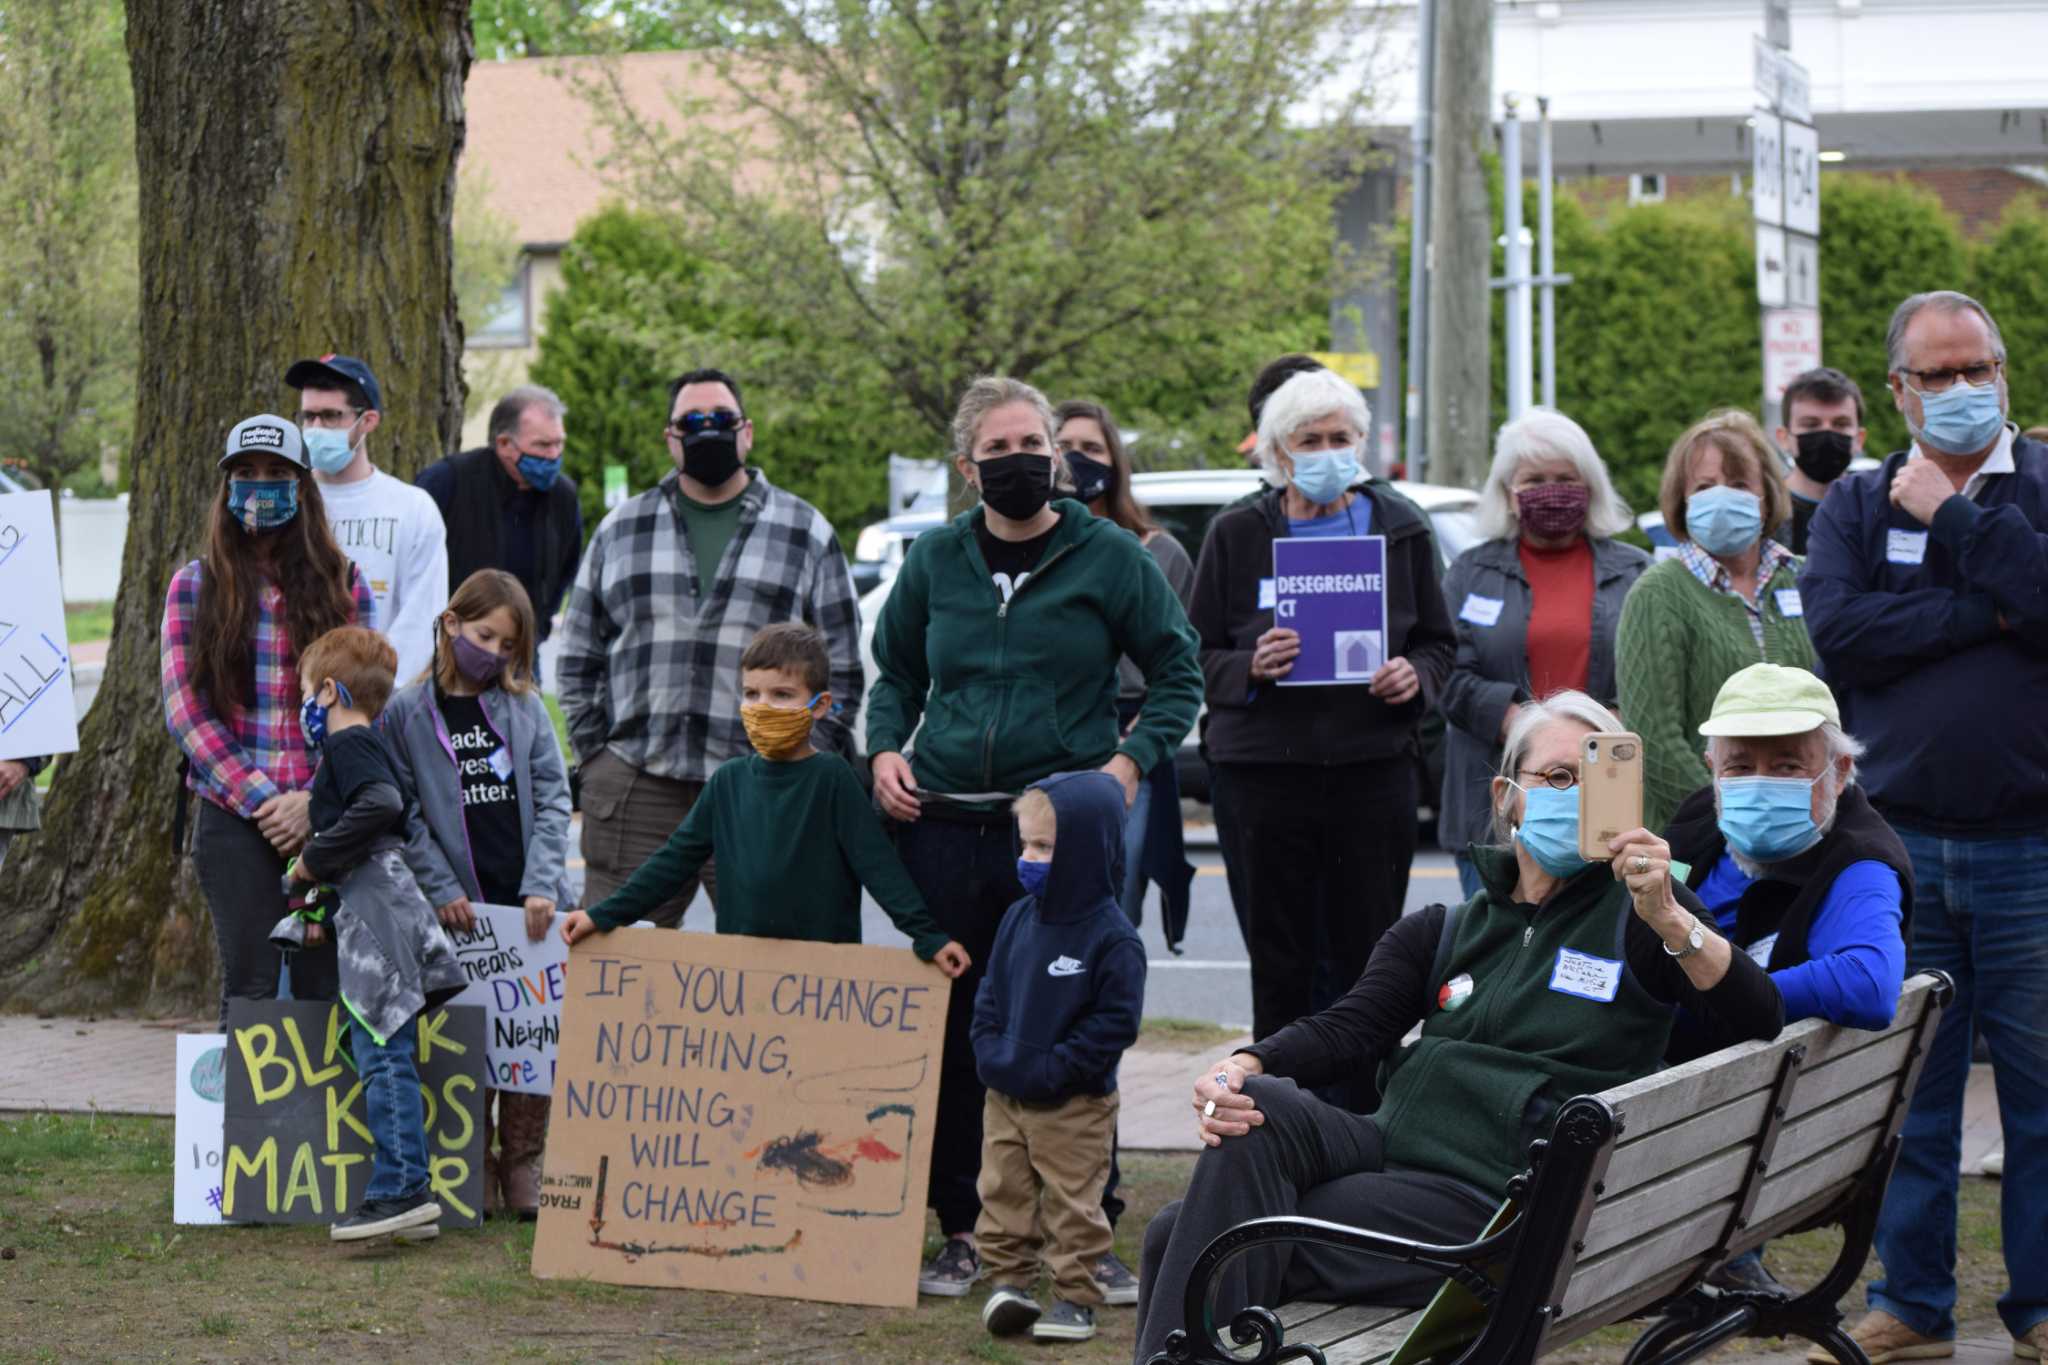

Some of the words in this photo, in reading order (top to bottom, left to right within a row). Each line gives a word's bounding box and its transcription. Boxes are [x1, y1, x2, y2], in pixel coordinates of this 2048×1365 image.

[241, 437, 280, 447] inclusive
[242, 427, 282, 440] radically
[1277, 573, 1382, 595] DESEGREGATE
[1277, 599, 1297, 618] CT
[585, 959, 643, 998] IF
[673, 962, 746, 1016] YOU
[771, 974, 929, 1032] CHANGE
[235, 1004, 467, 1106] BLK
[595, 1022, 793, 1079] NOTHING,
[565, 1080, 736, 1128] NOTHING
[630, 1132, 710, 1169] WILL
[222, 1136, 477, 1220] MATR
[539, 1193, 582, 1210] FRAG
[622, 1182, 777, 1229] CHANGE
